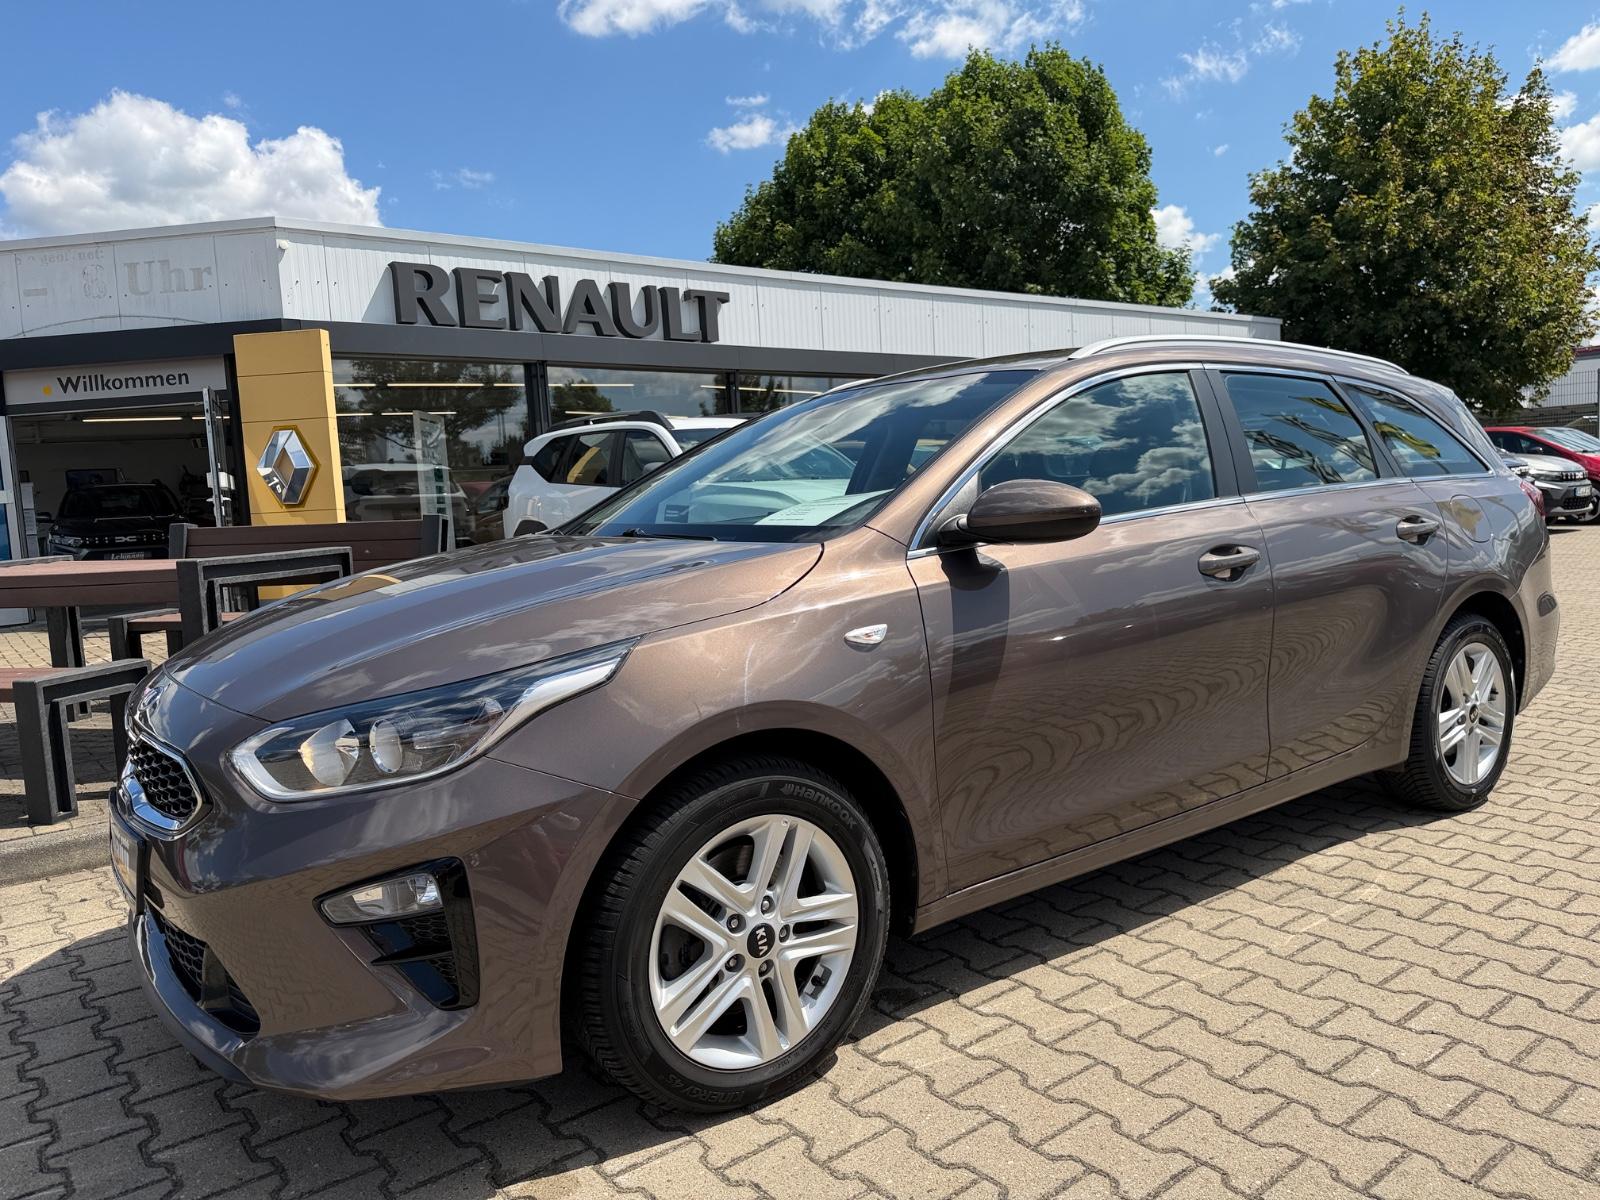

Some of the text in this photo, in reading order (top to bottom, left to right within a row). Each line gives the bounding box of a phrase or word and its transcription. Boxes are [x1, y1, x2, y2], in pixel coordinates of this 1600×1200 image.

[123, 259, 212, 296] Uhr
[388, 261, 730, 343] RENAULT
[57, 371, 190, 394] Willkommen
[755, 926, 769, 956] KIA
